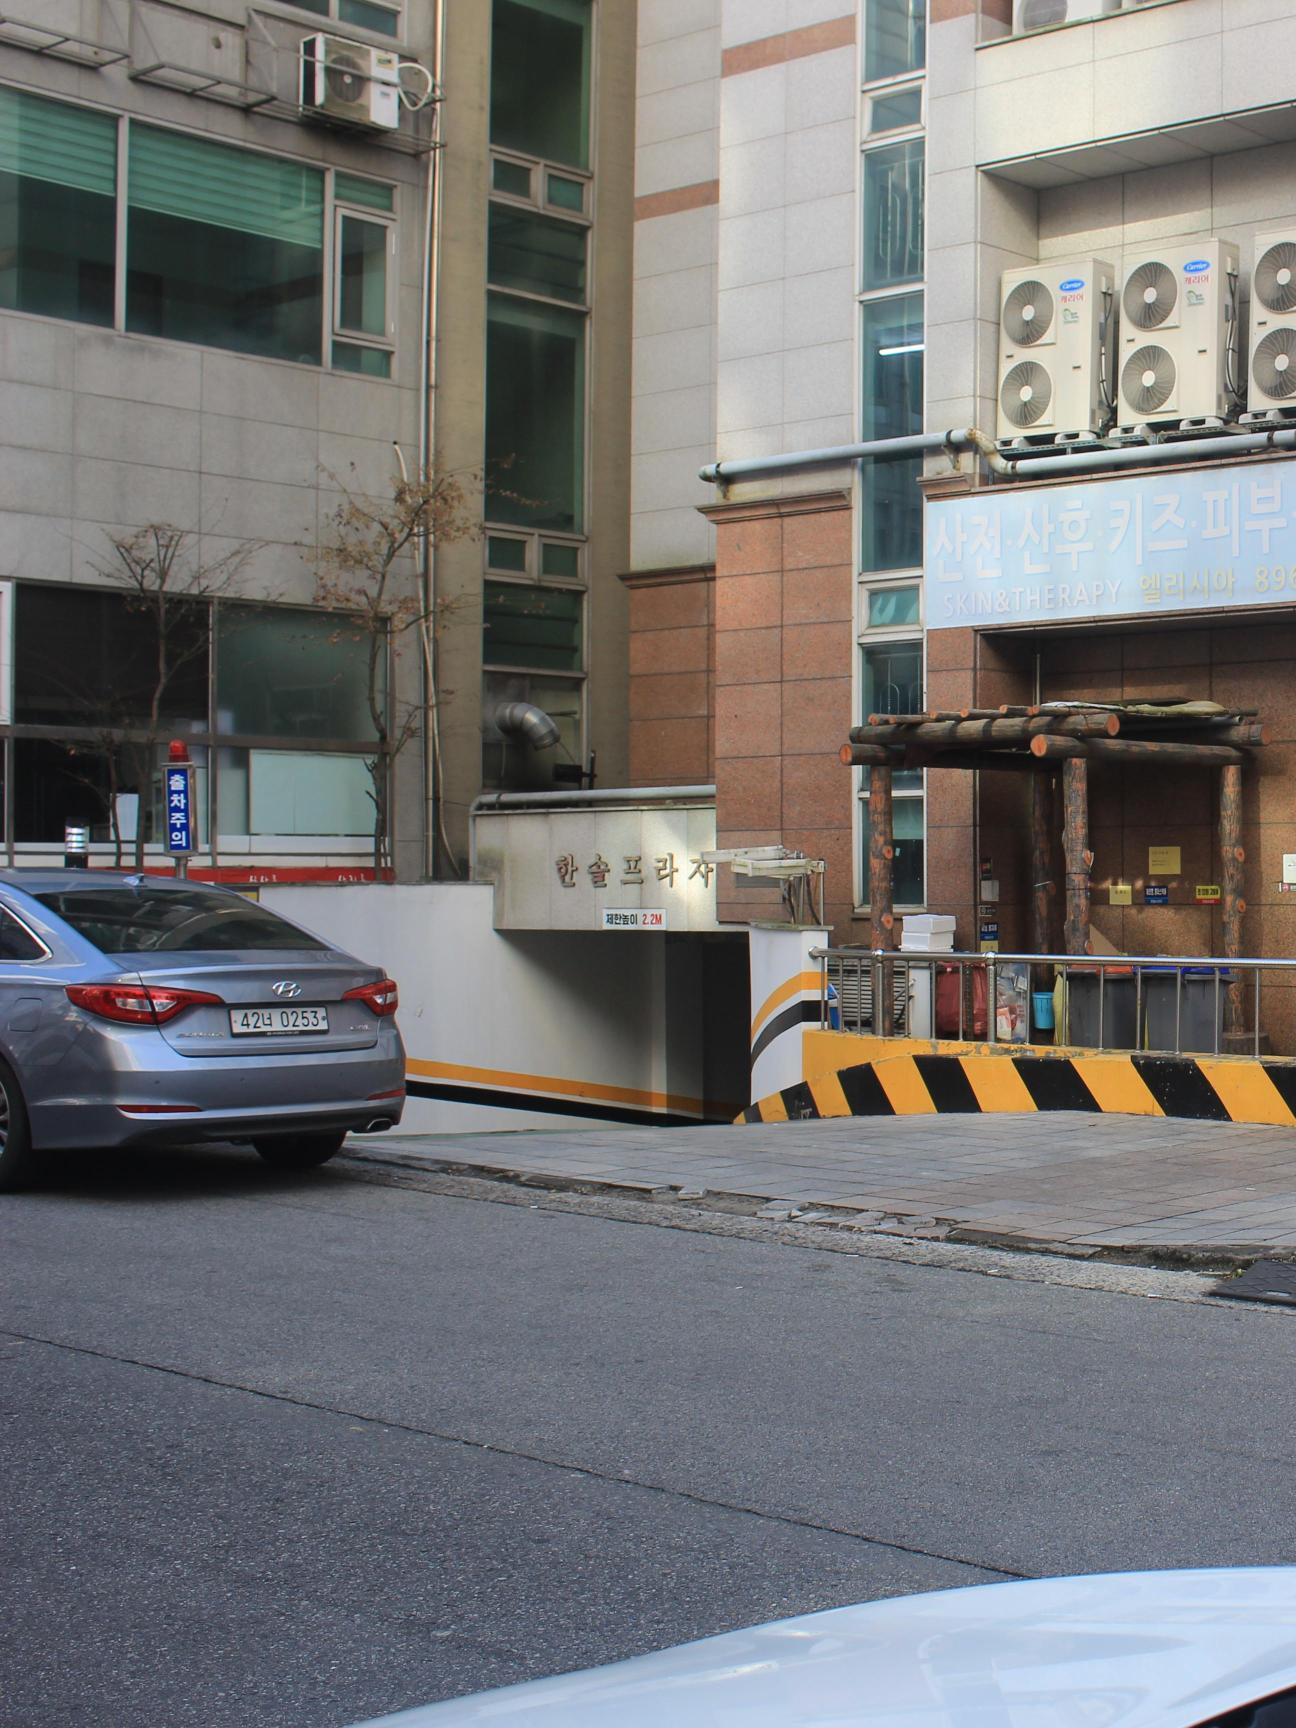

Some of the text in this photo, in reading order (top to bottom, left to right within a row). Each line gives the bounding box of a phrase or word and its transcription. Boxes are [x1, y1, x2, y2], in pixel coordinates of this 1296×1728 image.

[943, 578, 1121, 619] SKIN&THERAPY
[169, 774, 187, 847] 출차주의
[555, 853, 714, 888] 한솔프라자
[606, 913, 662, 925] 제한높이 2.2M
[240, 1011, 319, 1030] 42너 0253
